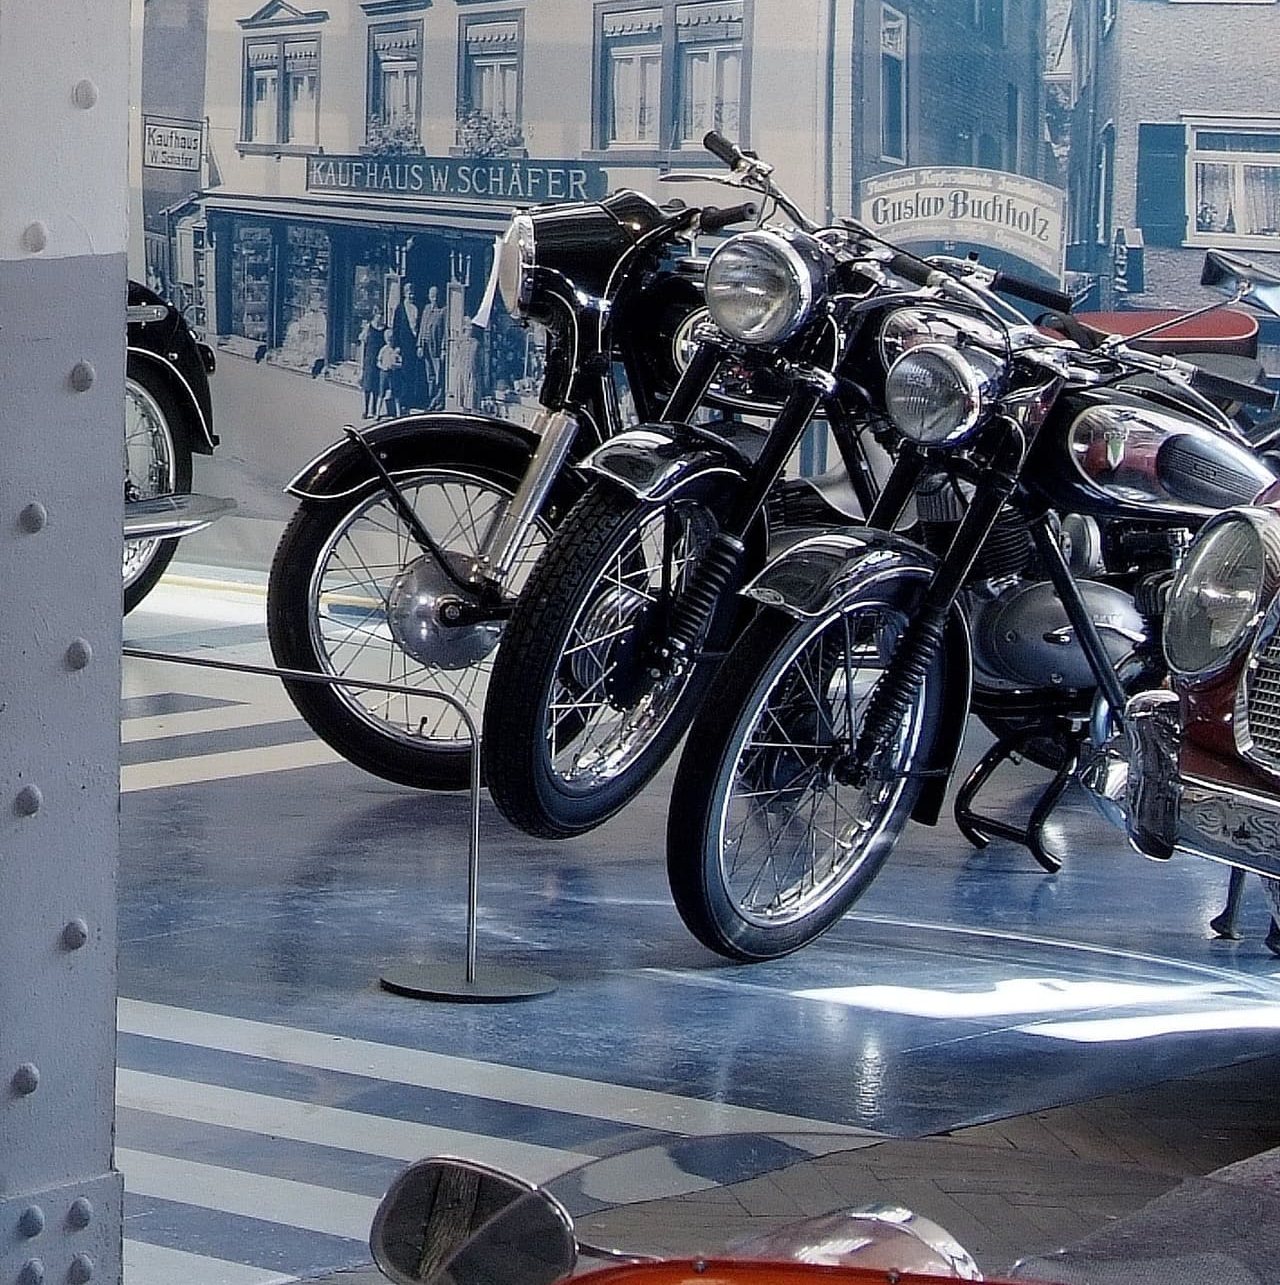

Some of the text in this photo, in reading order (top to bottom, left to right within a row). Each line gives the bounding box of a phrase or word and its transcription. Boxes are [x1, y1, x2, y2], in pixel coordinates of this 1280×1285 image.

[147, 126, 198, 151] Kaufhaus
[311, 163, 424, 192] KAUFHAUS
[457, 162, 588, 200] SCHÄFER
[872, 192, 944, 226] Gustav
[949, 189, 1048, 242] Buchholz
